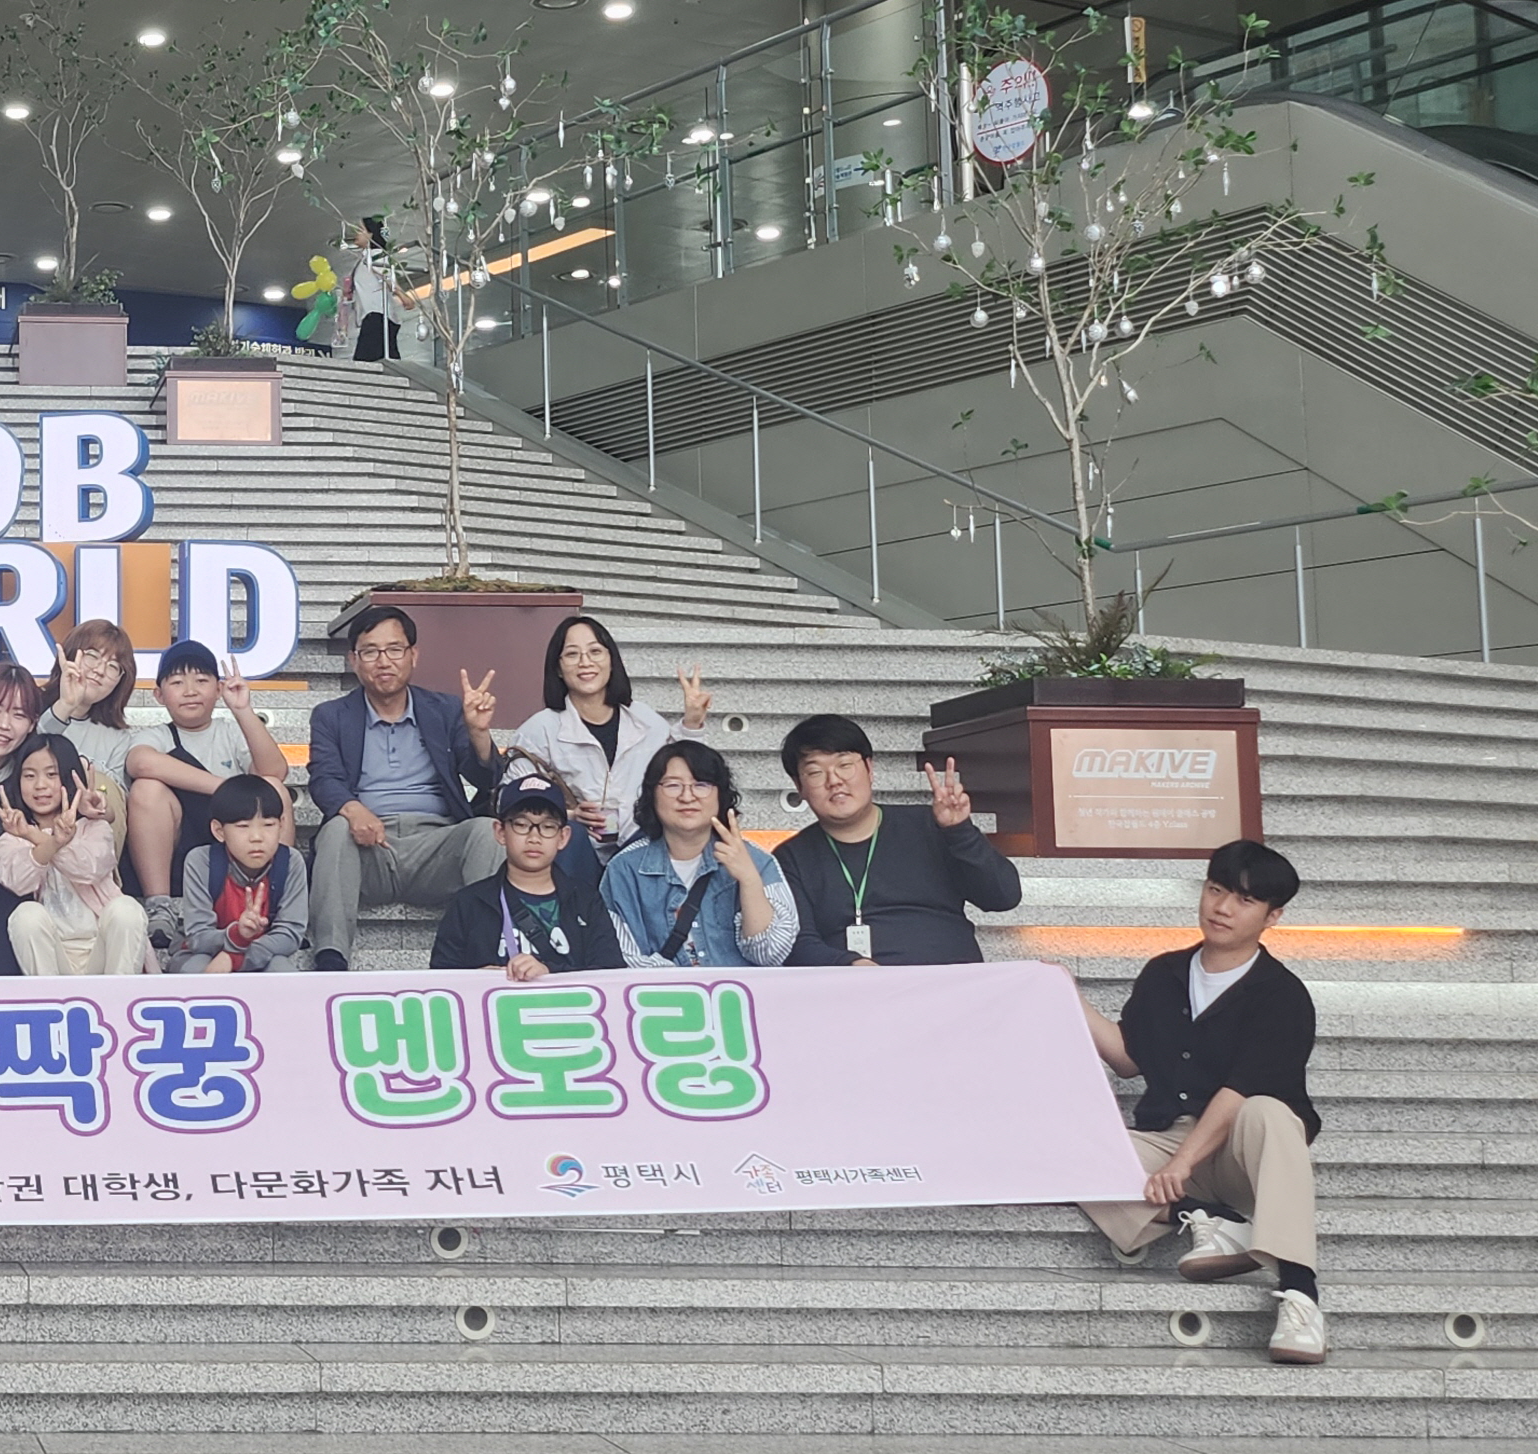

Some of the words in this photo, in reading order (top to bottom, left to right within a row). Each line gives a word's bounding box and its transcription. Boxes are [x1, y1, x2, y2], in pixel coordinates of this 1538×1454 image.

[1072, 748, 1217, 779] MAKIVE
[325, 980, 771, 1130] 멘토링
[63, 1171, 193, 1202] 대학생,
[209, 1168, 410, 1200] 다문화가족
[424, 1166, 505, 1197] 자녀
[600, 1162, 702, 1188] 평택시
[744, 1162, 775, 1181] 가족
[793, 1165, 924, 1186] 평택시가족센터
